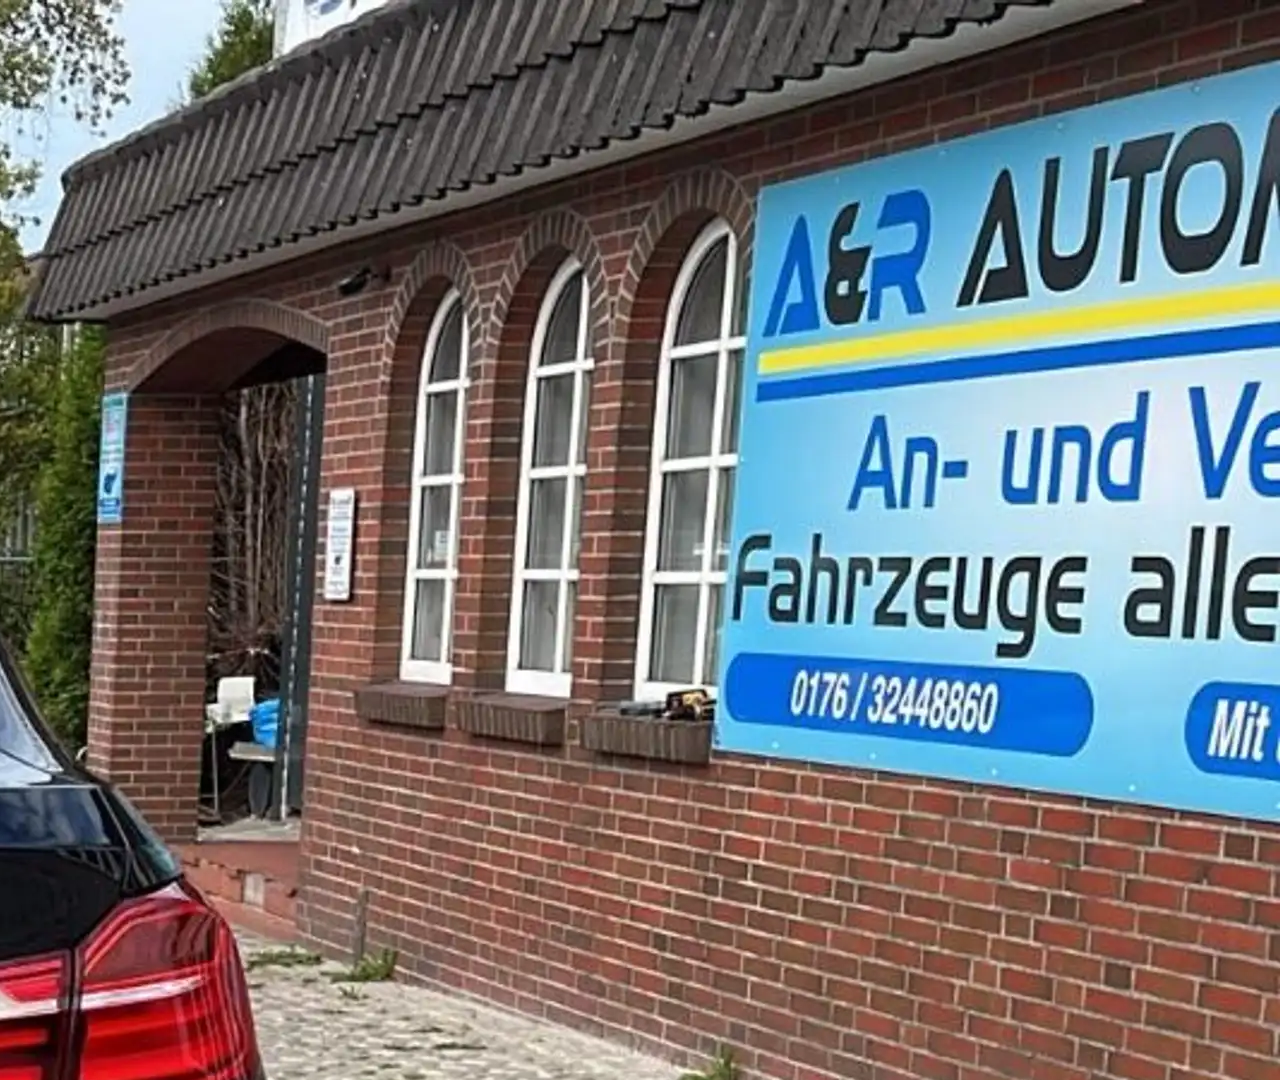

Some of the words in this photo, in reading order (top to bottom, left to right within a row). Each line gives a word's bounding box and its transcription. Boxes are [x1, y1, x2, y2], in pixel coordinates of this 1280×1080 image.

[763, 190, 931, 337] A&R
[848, 415, 968, 511] An-
[1001, 391, 1150, 505] und
[732, 534, 1088, 659] Fahrzeuge
[1206, 698, 1271, 761] Mit
